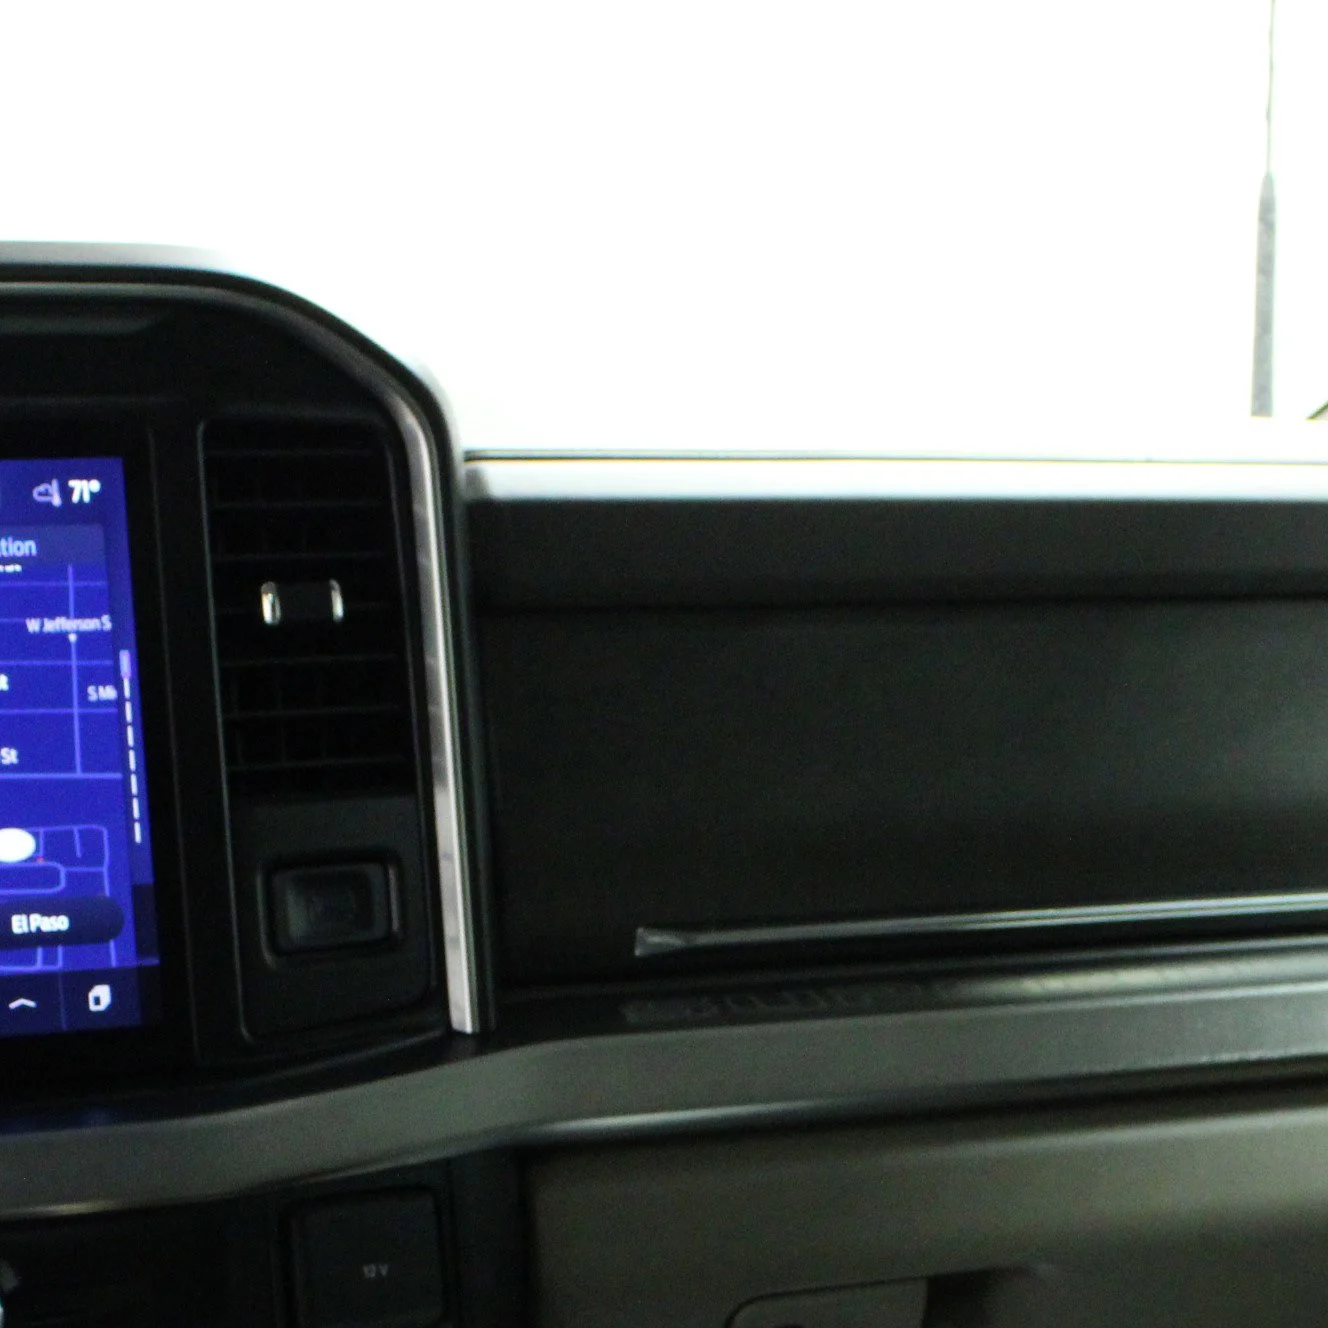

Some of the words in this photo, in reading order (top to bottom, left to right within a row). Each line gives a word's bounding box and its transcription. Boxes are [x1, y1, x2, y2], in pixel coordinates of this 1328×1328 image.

[25, 618, 41, 634] W
[42, 615, 102, 633] Jefferson
[1, 747, 19, 765] St
[11, 914, 28, 934] El
[29, 912, 70, 933] Paso
